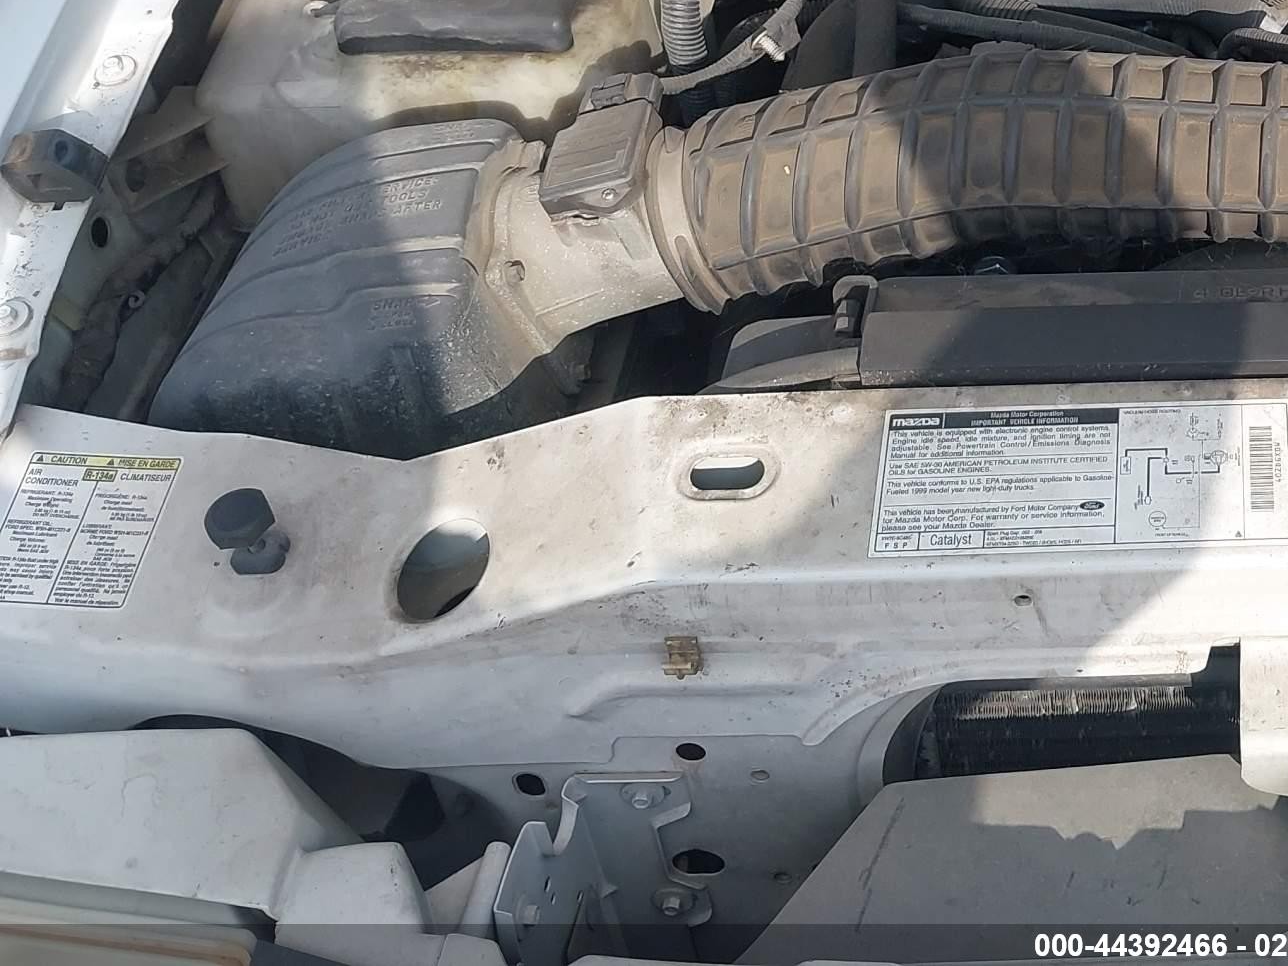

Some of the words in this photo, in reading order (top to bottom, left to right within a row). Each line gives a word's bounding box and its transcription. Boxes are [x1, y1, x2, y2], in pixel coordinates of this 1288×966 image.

[893, 418, 940, 426] mazda
[50, 455, 88, 463] CAUTION
[25, 477, 79, 485] CONDITIONER
[119, 473, 171, 481] CLIMATISEUR
[929, 533, 972, 548] Catalyst
